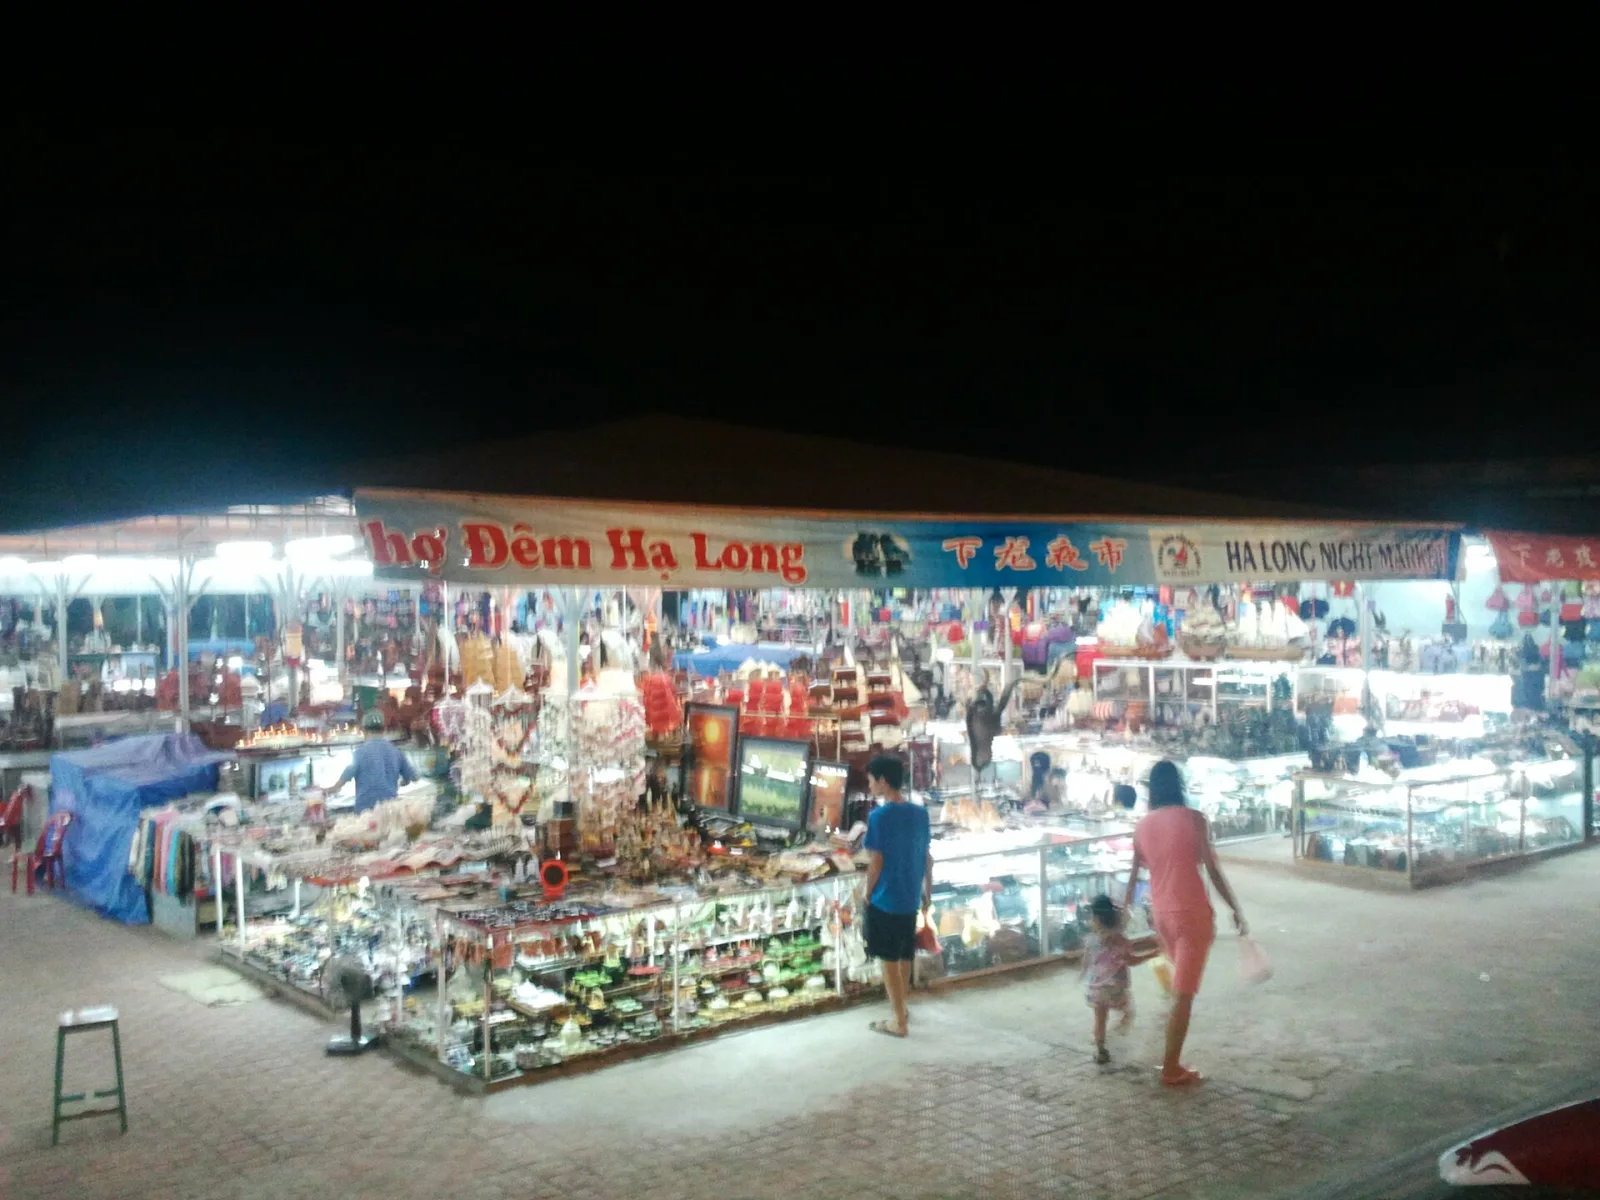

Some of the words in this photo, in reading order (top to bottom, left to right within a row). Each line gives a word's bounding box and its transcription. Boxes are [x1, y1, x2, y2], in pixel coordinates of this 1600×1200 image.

[360, 519, 447, 576] hợ
[461, 522, 592, 569] Đêm
[606, 528, 677, 580] Hạ
[690, 532, 807, 583] Long
[1225, 541, 1257, 573] HA
[1259, 541, 1316, 573] LONG
[1320, 542, 1375, 573] NIGHT
